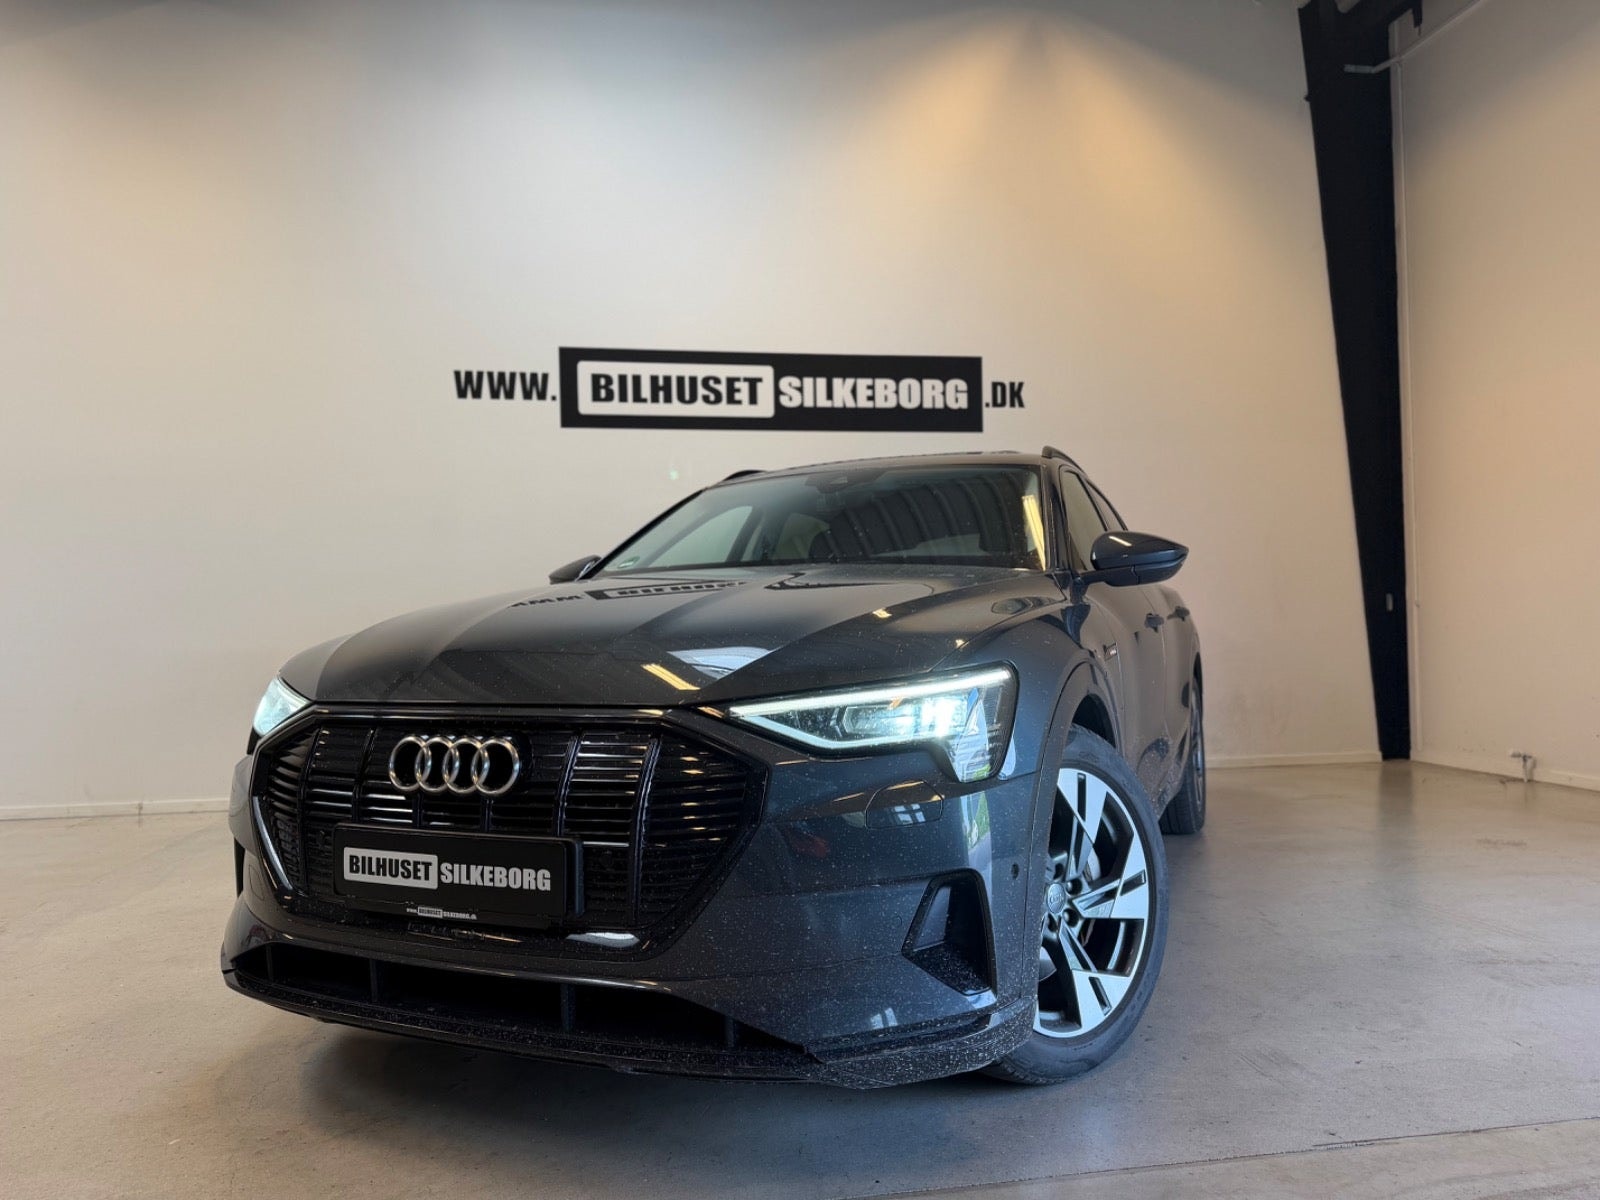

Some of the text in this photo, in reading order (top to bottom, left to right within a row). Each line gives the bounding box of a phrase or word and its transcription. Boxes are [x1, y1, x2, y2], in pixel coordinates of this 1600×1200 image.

[454, 370, 1025, 409] WWW. BILHUSET SILKEBORG .DK
[349, 855, 551, 891] BILHUSET SILKEBORG
